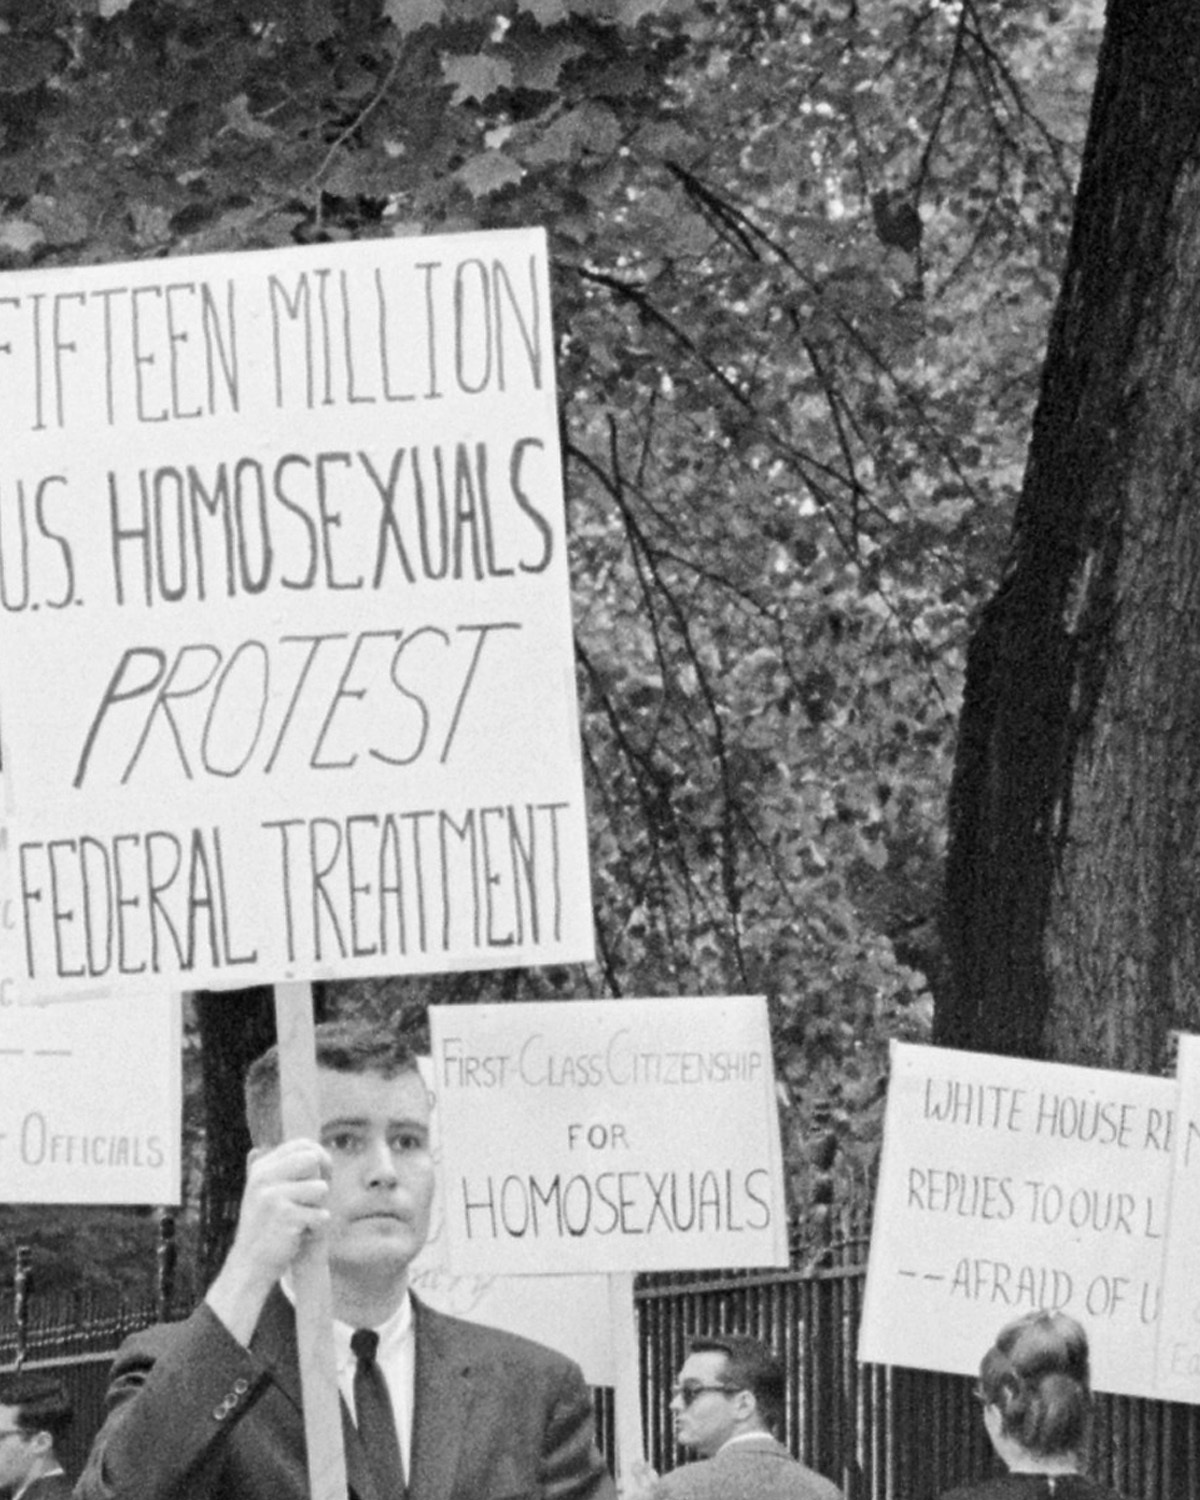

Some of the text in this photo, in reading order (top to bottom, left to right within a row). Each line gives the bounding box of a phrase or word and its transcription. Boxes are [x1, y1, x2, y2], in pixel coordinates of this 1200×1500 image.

[267, 254, 544, 409] MILLION
[107, 436, 554, 607] HOMOSEXUALS
[73, 622, 523, 790] PROTEST
[18, 802, 570, 979] FEDERAL TREATMENT
[606, 1028, 762, 1086] CITIZENSHIP
[19, 1111, 166, 1169] OFFICIALS
[567, 1122, 630, 1151] FOR
[923, 1077, 1026, 1133] WHITE
[1036, 1093, 1138, 1149] HOUSE
[461, 1168, 772, 1240] HOMOSEXUALS
[906, 1167, 1015, 1221] REPLIES
[1025, 1180, 1063, 1226] TO
[1068, 1188, 1136, 1237] OUR
[1085, 1274, 1131, 1319] OF
